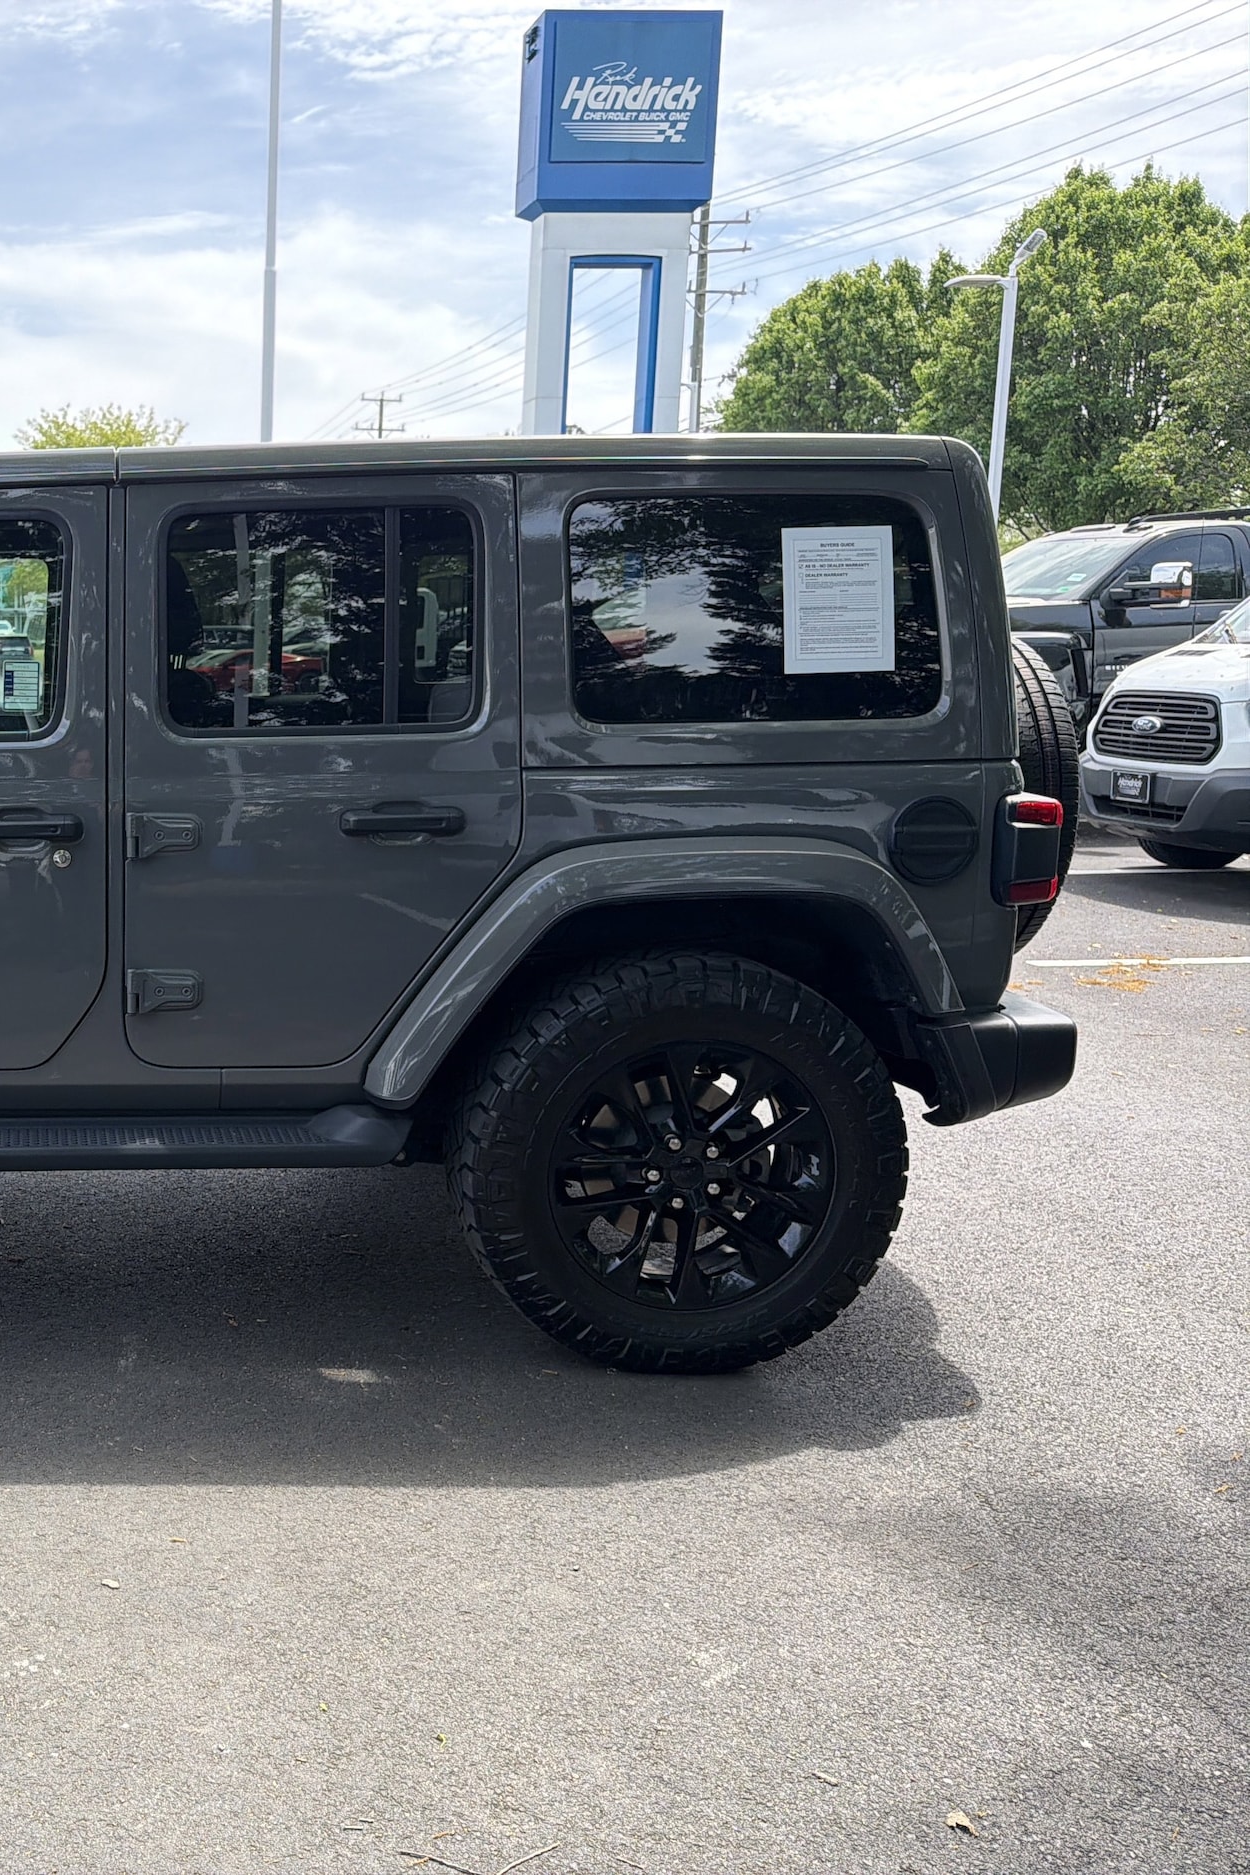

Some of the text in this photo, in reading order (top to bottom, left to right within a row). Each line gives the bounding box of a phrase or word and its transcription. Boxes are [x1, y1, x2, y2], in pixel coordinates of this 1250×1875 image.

[560, 76, 702, 120] Hendrick
[583, 112, 691, 121] CHEVROLET BUICK GMC
